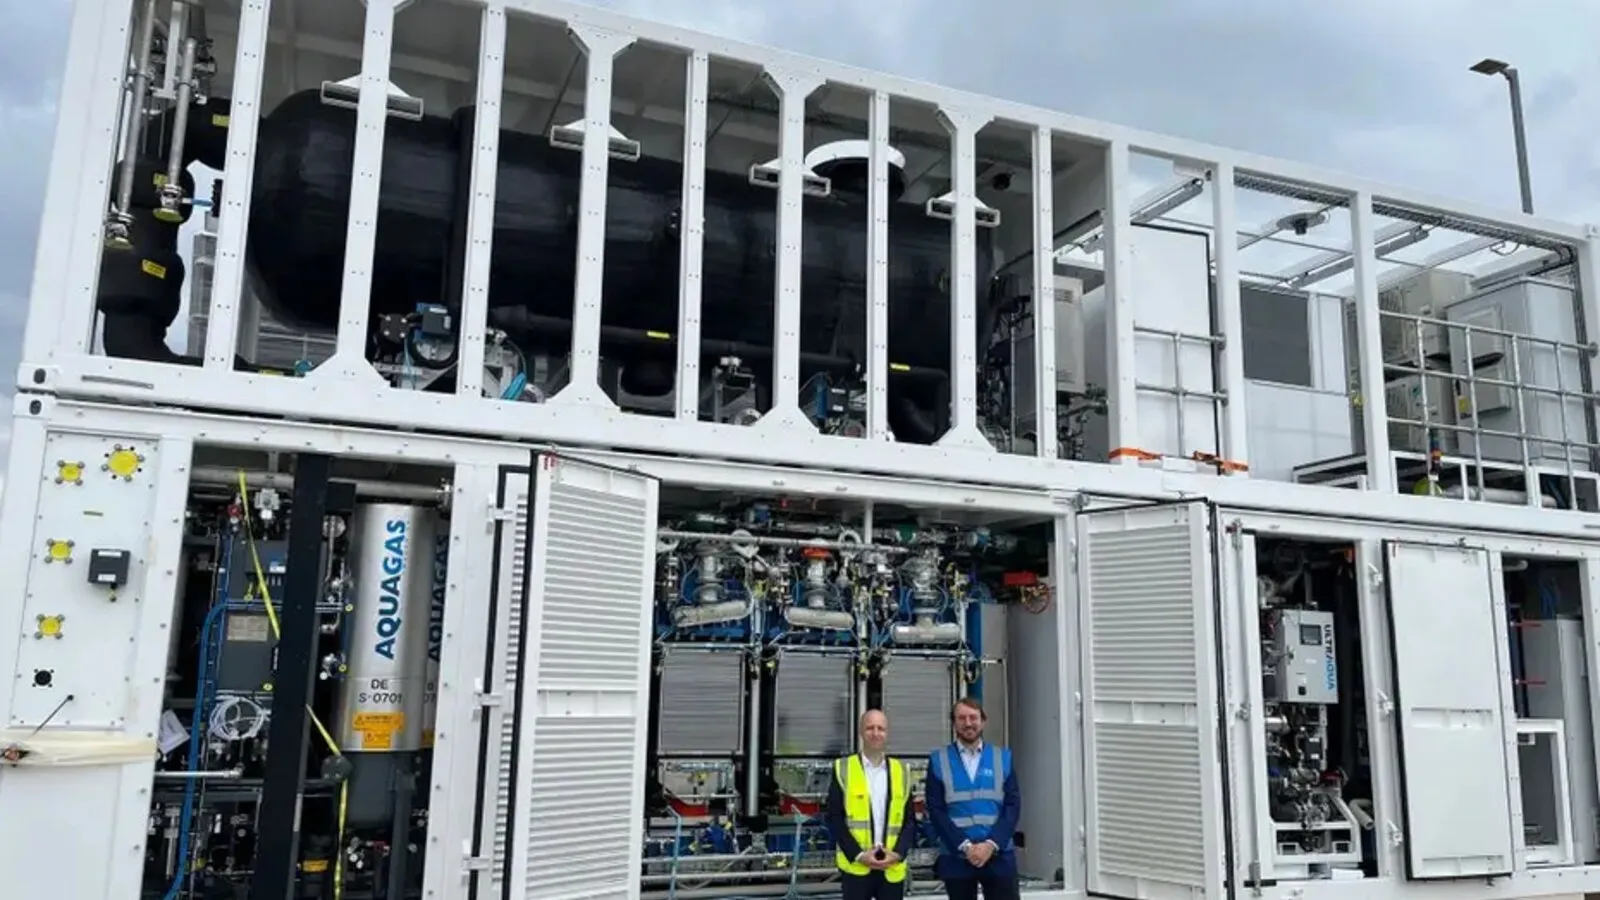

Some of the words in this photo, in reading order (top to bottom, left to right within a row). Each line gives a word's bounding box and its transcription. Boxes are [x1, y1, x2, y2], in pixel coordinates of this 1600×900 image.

[375, 520, 406, 660] AQUAGAS
[371, 679, 388, 690] DE
[359, 692, 402, 704] S-0701
